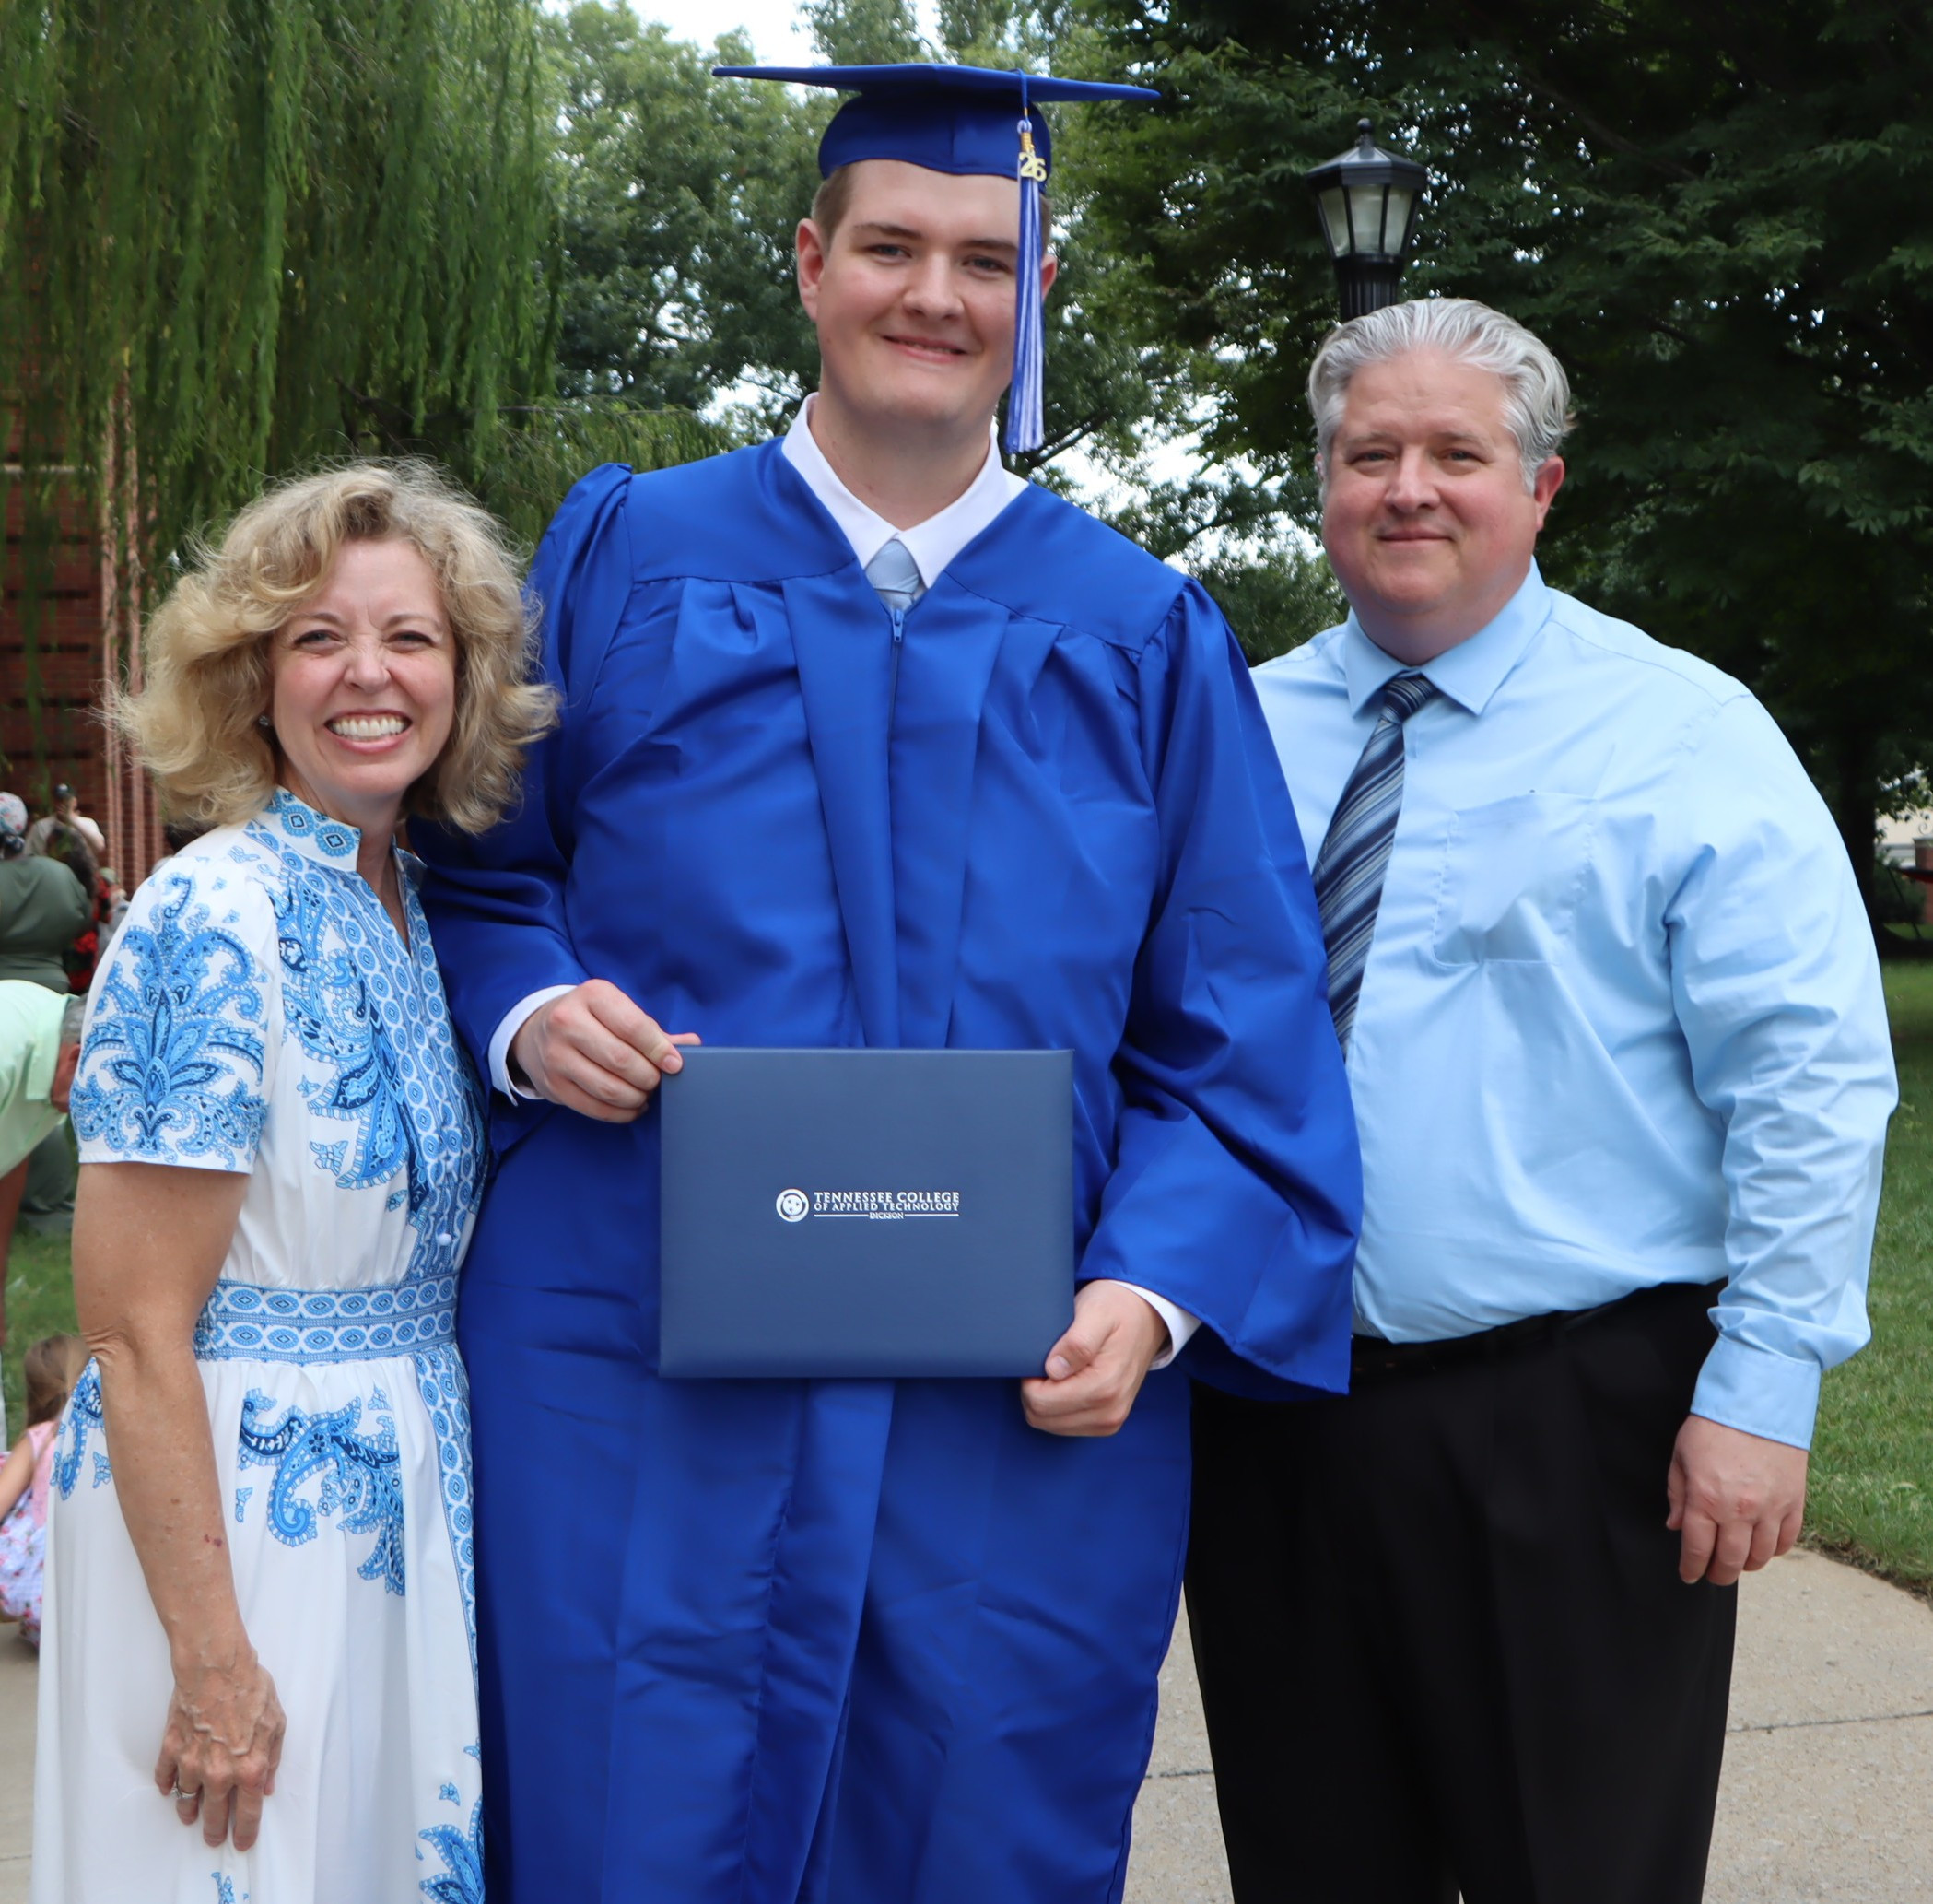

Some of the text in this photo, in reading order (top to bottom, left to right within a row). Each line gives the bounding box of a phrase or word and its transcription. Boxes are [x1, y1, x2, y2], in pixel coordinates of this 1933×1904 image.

[814, 1192, 959, 1203] TENNESSEE COLLEGE
[814, 1202, 959, 1211] OF APPLIED TECHNOLOGY
